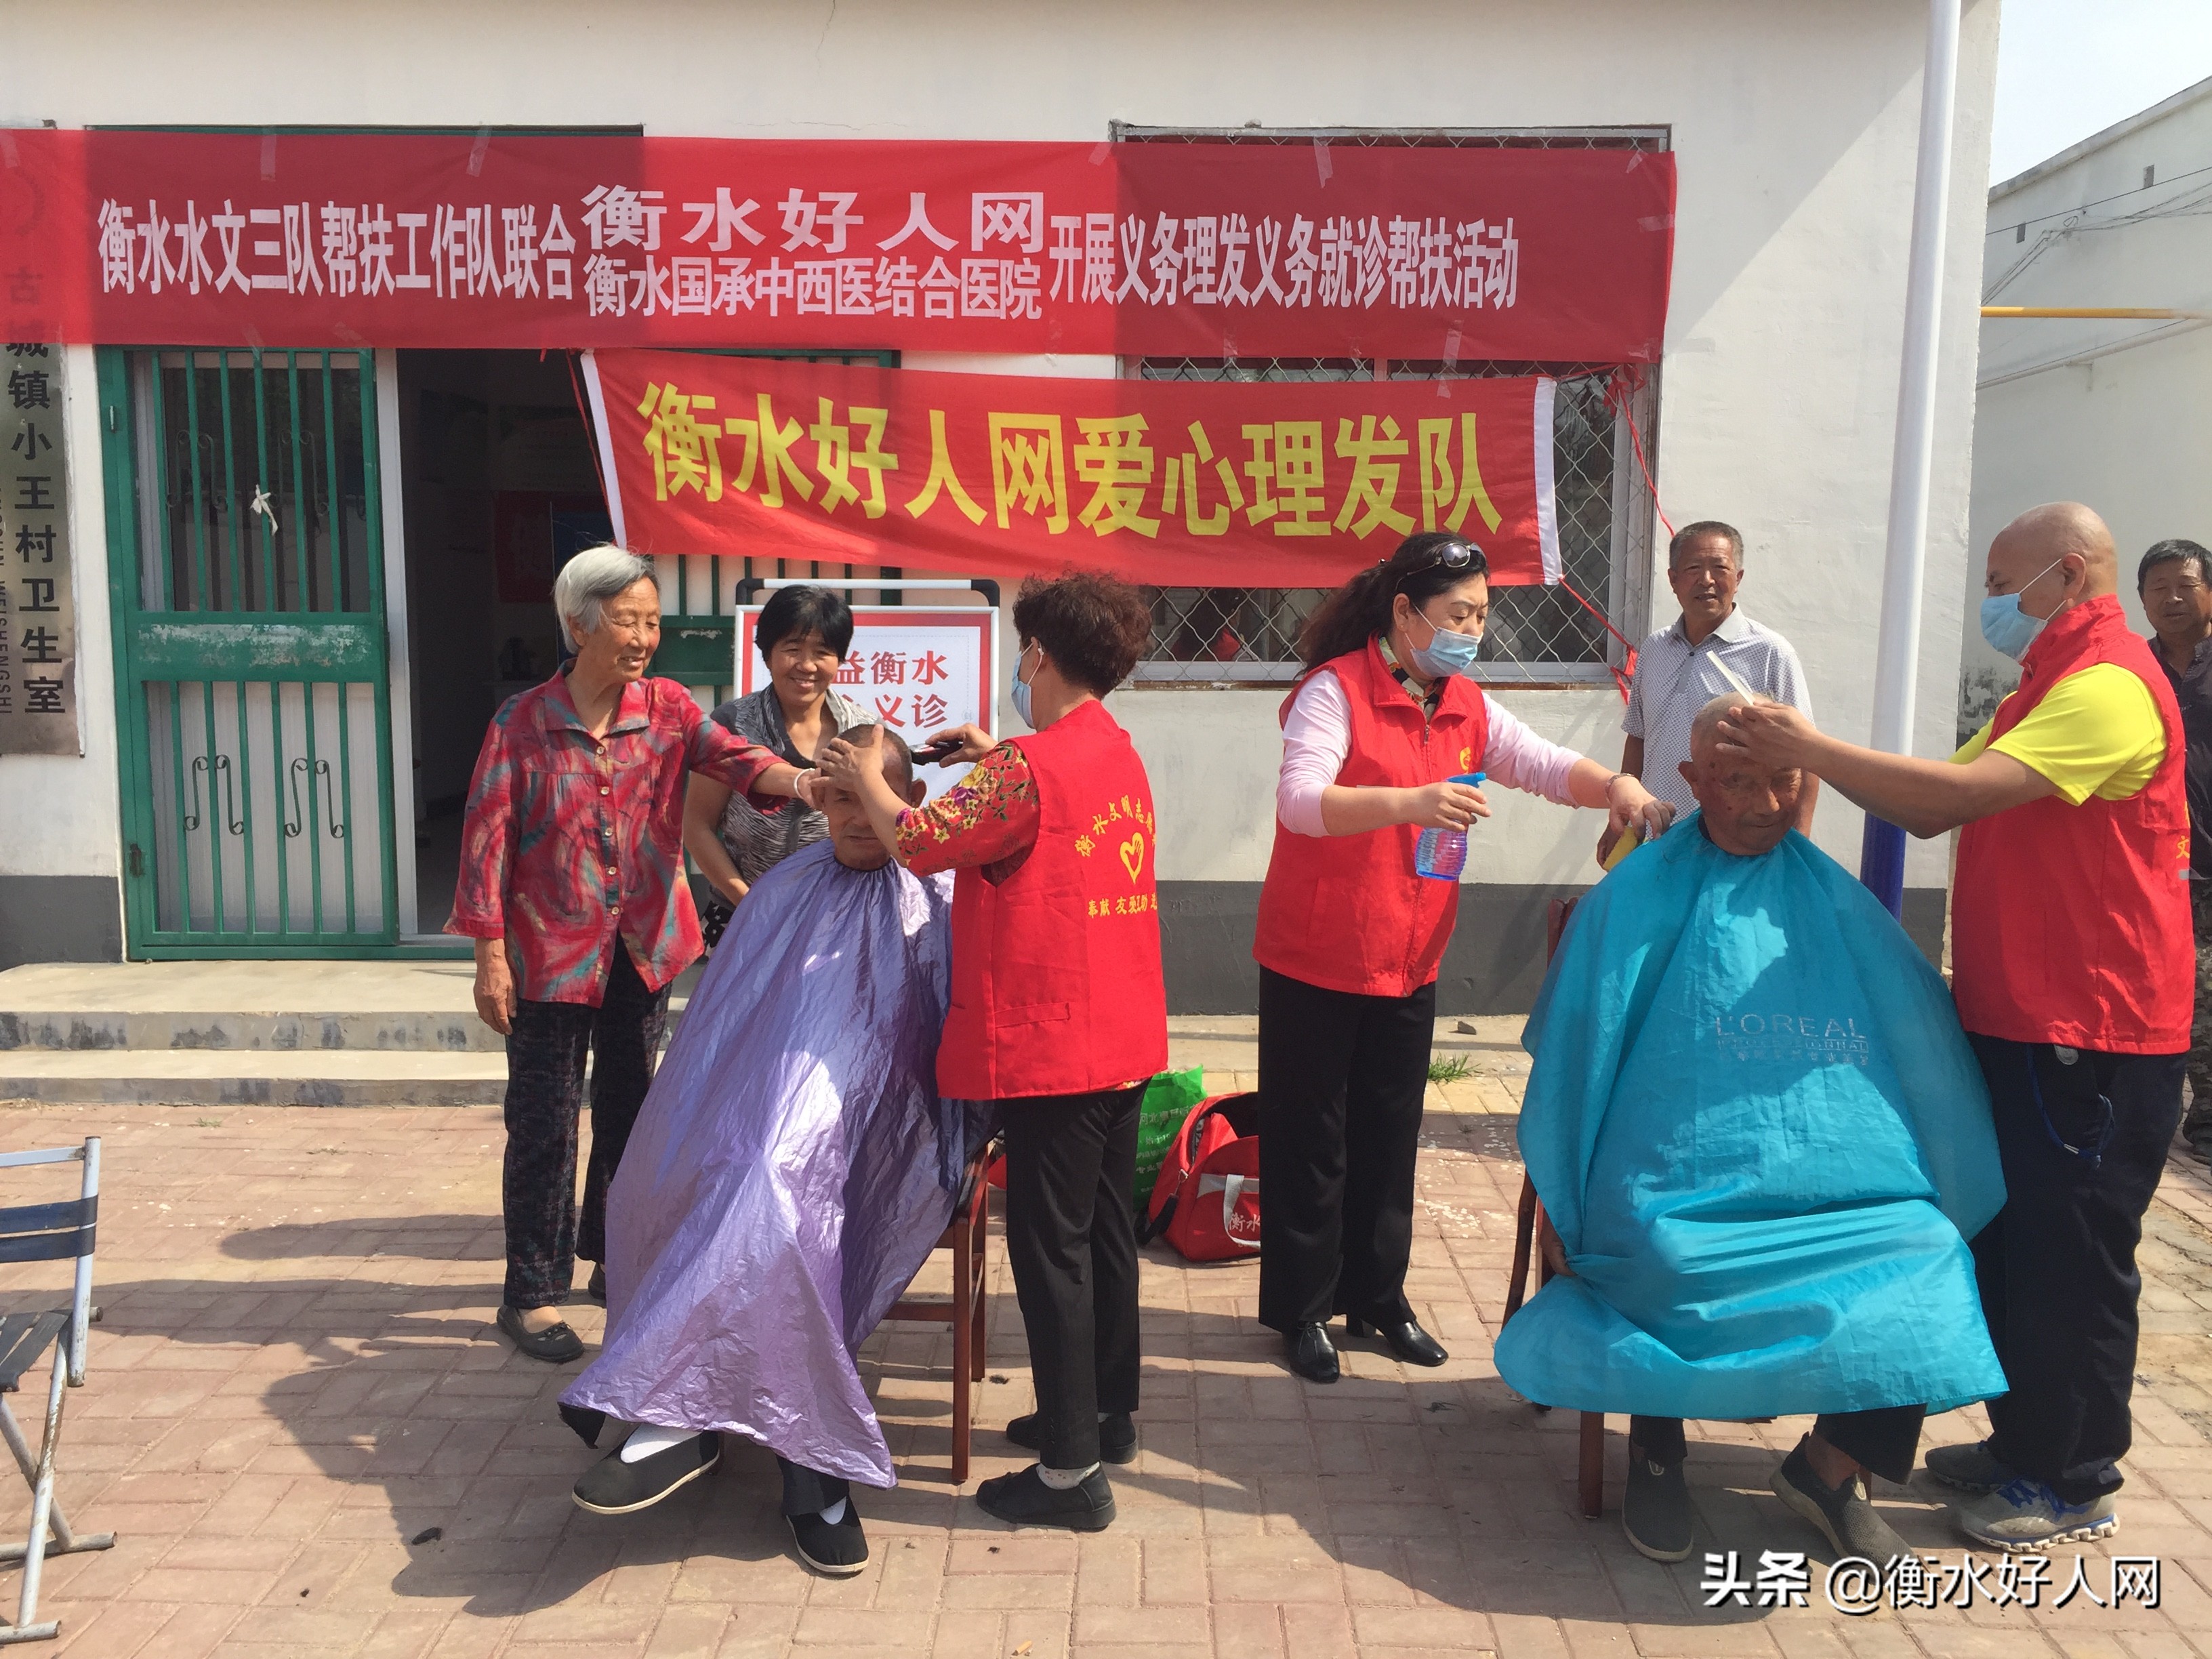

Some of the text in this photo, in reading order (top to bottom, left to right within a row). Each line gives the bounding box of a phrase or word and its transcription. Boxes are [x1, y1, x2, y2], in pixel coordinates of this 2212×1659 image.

[98, 198, 576, 300] 衡水水文三队帮扶工作队联合
[581, 184, 1044, 253] 衡水好人网
[583, 253, 1043, 320] 衡水国承中西医结合医院
[1050, 212, 1519, 311] 开展义务理发义务就诊帮扶活动
[637, 381, 1502, 539] 衡水好人网爱心理发队
[842, 693, 948, 729] 义诊
